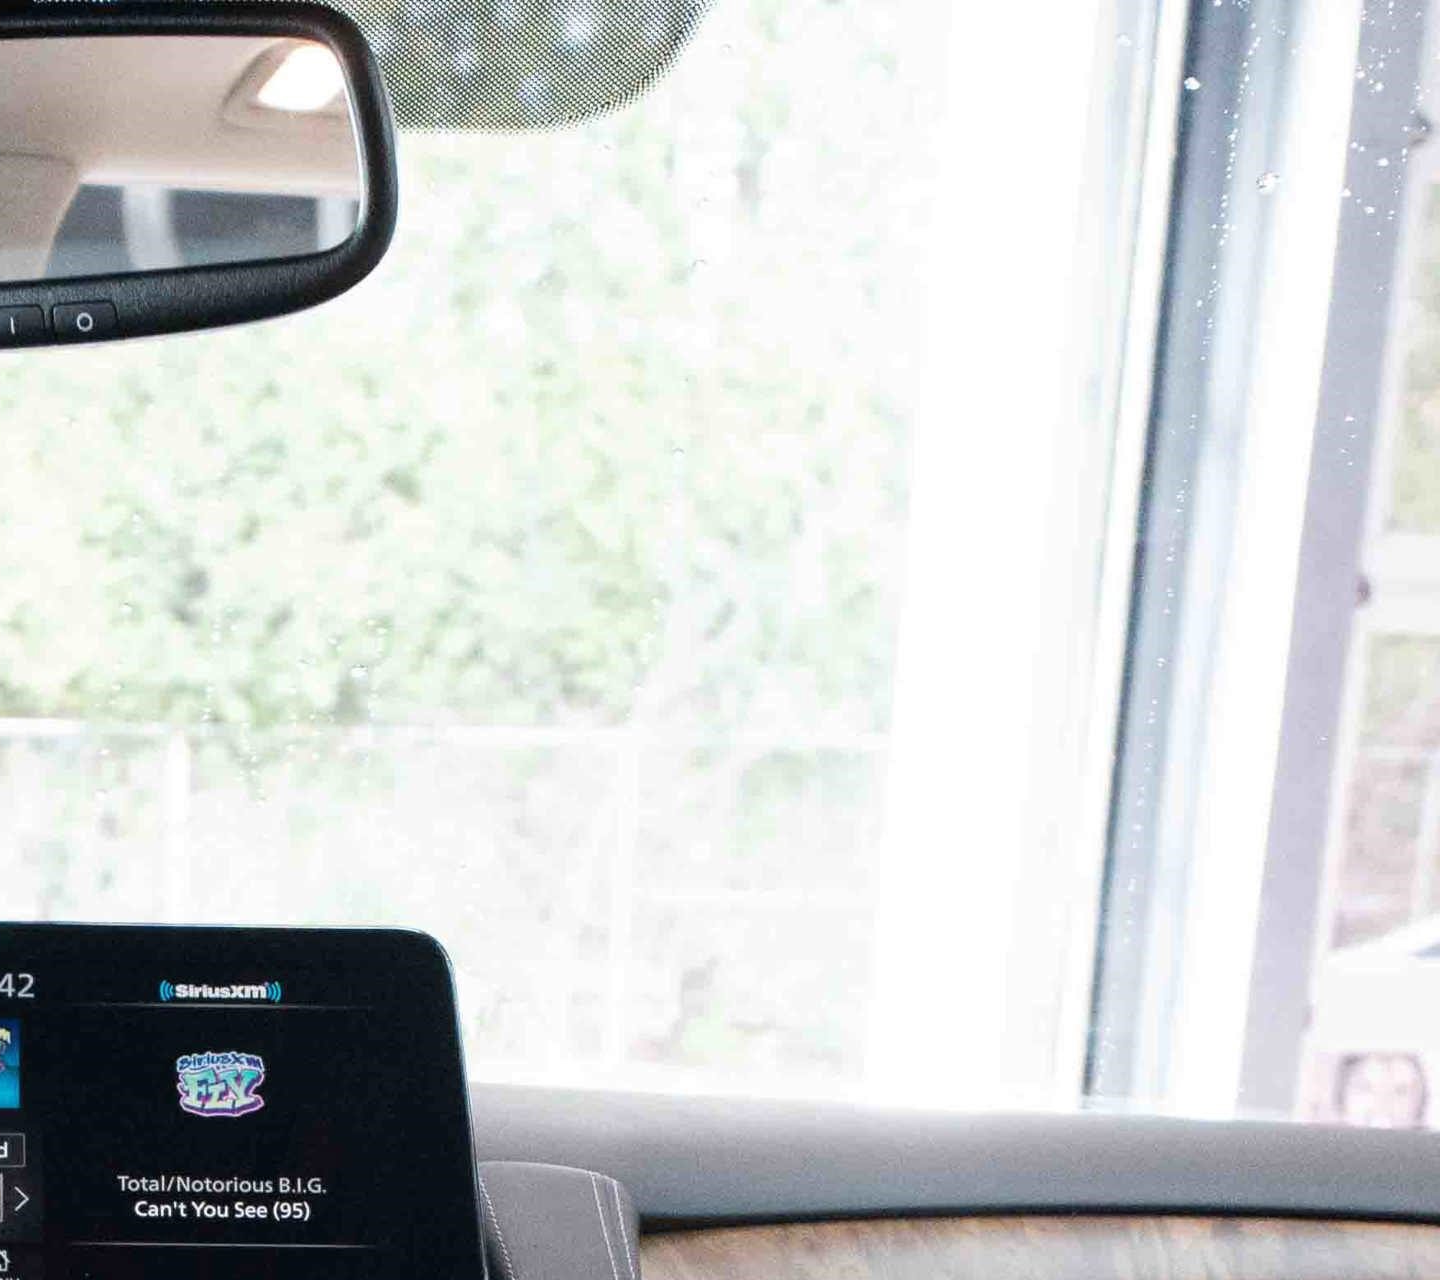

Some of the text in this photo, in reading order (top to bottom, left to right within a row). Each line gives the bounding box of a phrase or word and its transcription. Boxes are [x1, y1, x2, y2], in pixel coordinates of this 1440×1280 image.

[117, 1175, 327, 1194] Total/Notorious B.I.G.
[134, 1201, 310, 1221] Can't You See (95)
